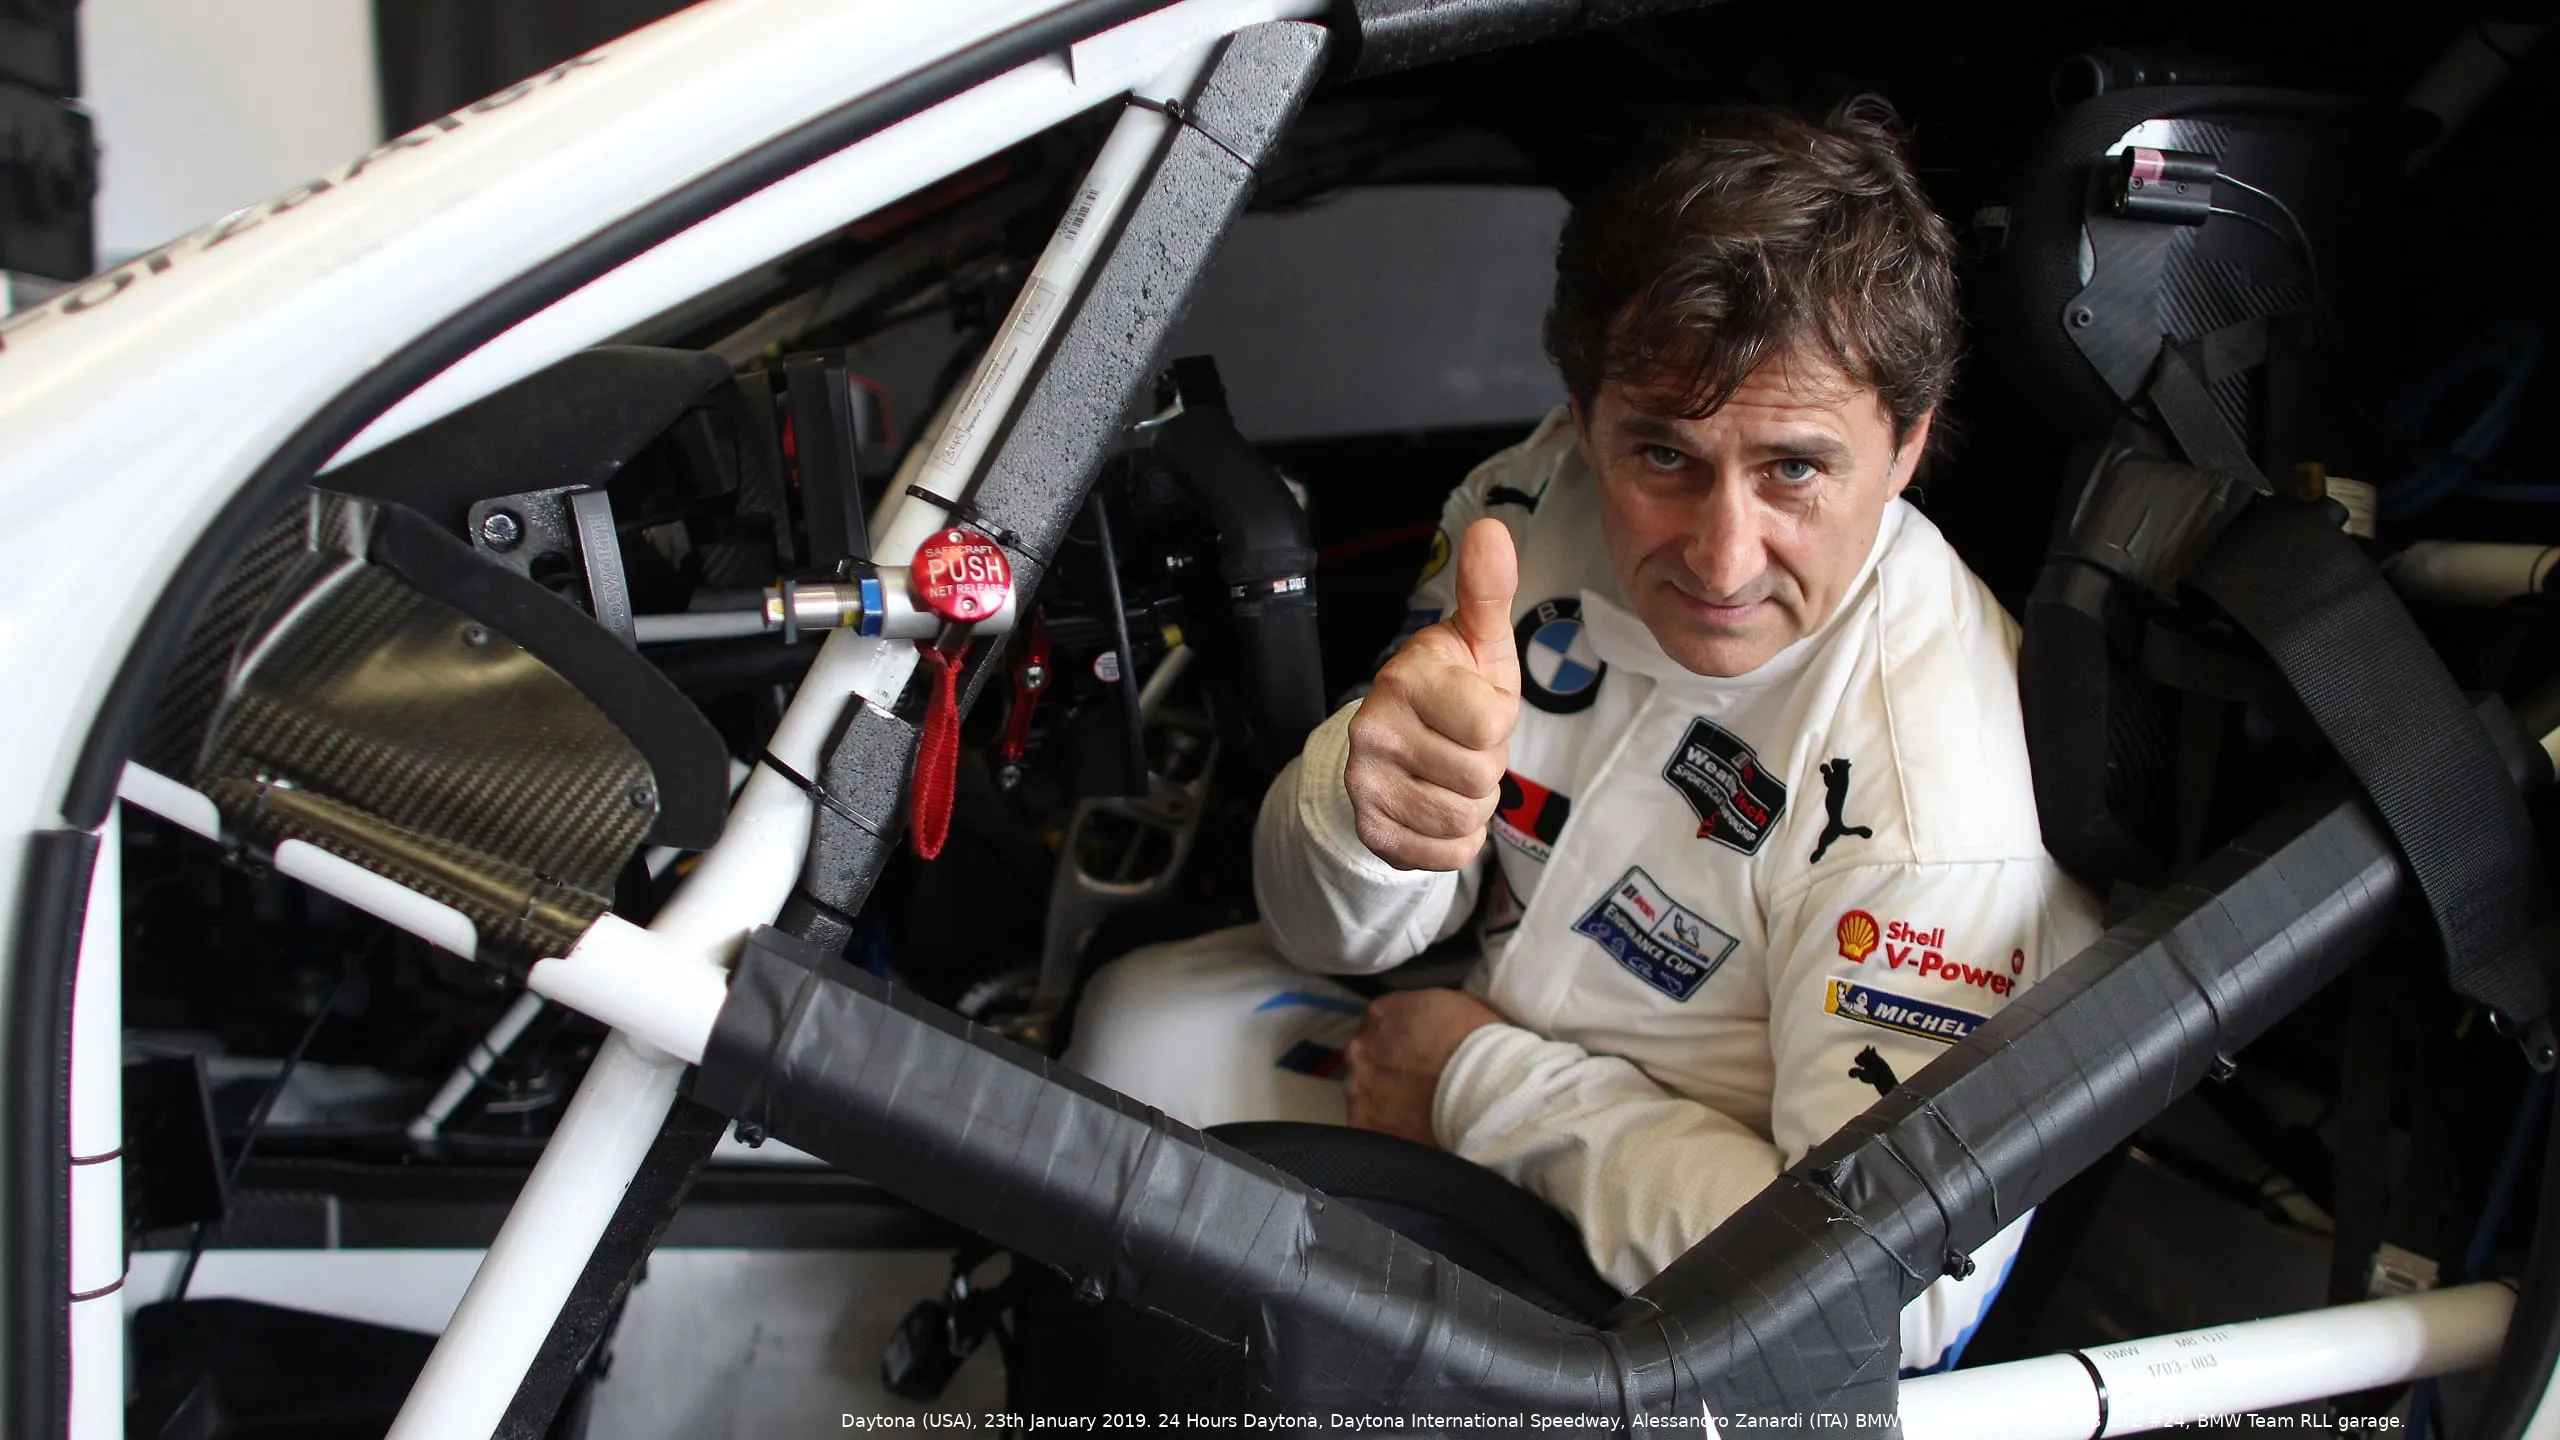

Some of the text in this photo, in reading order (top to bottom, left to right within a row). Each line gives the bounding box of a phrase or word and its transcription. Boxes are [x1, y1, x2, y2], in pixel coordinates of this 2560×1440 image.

[587, 511, 626, 632] COSWORTH
[928, 555, 1004, 585] PUSH
[930, 583, 1005, 598] NET RELEASE
[1886, 920, 1945, 948] Shell
[1664, 953, 1697, 978] CUP
[1885, 942, 2017, 998] V-Power
[1874, 1002, 1977, 1037] MICHEL
[2147, 1353, 2218, 1378] 1703-003
